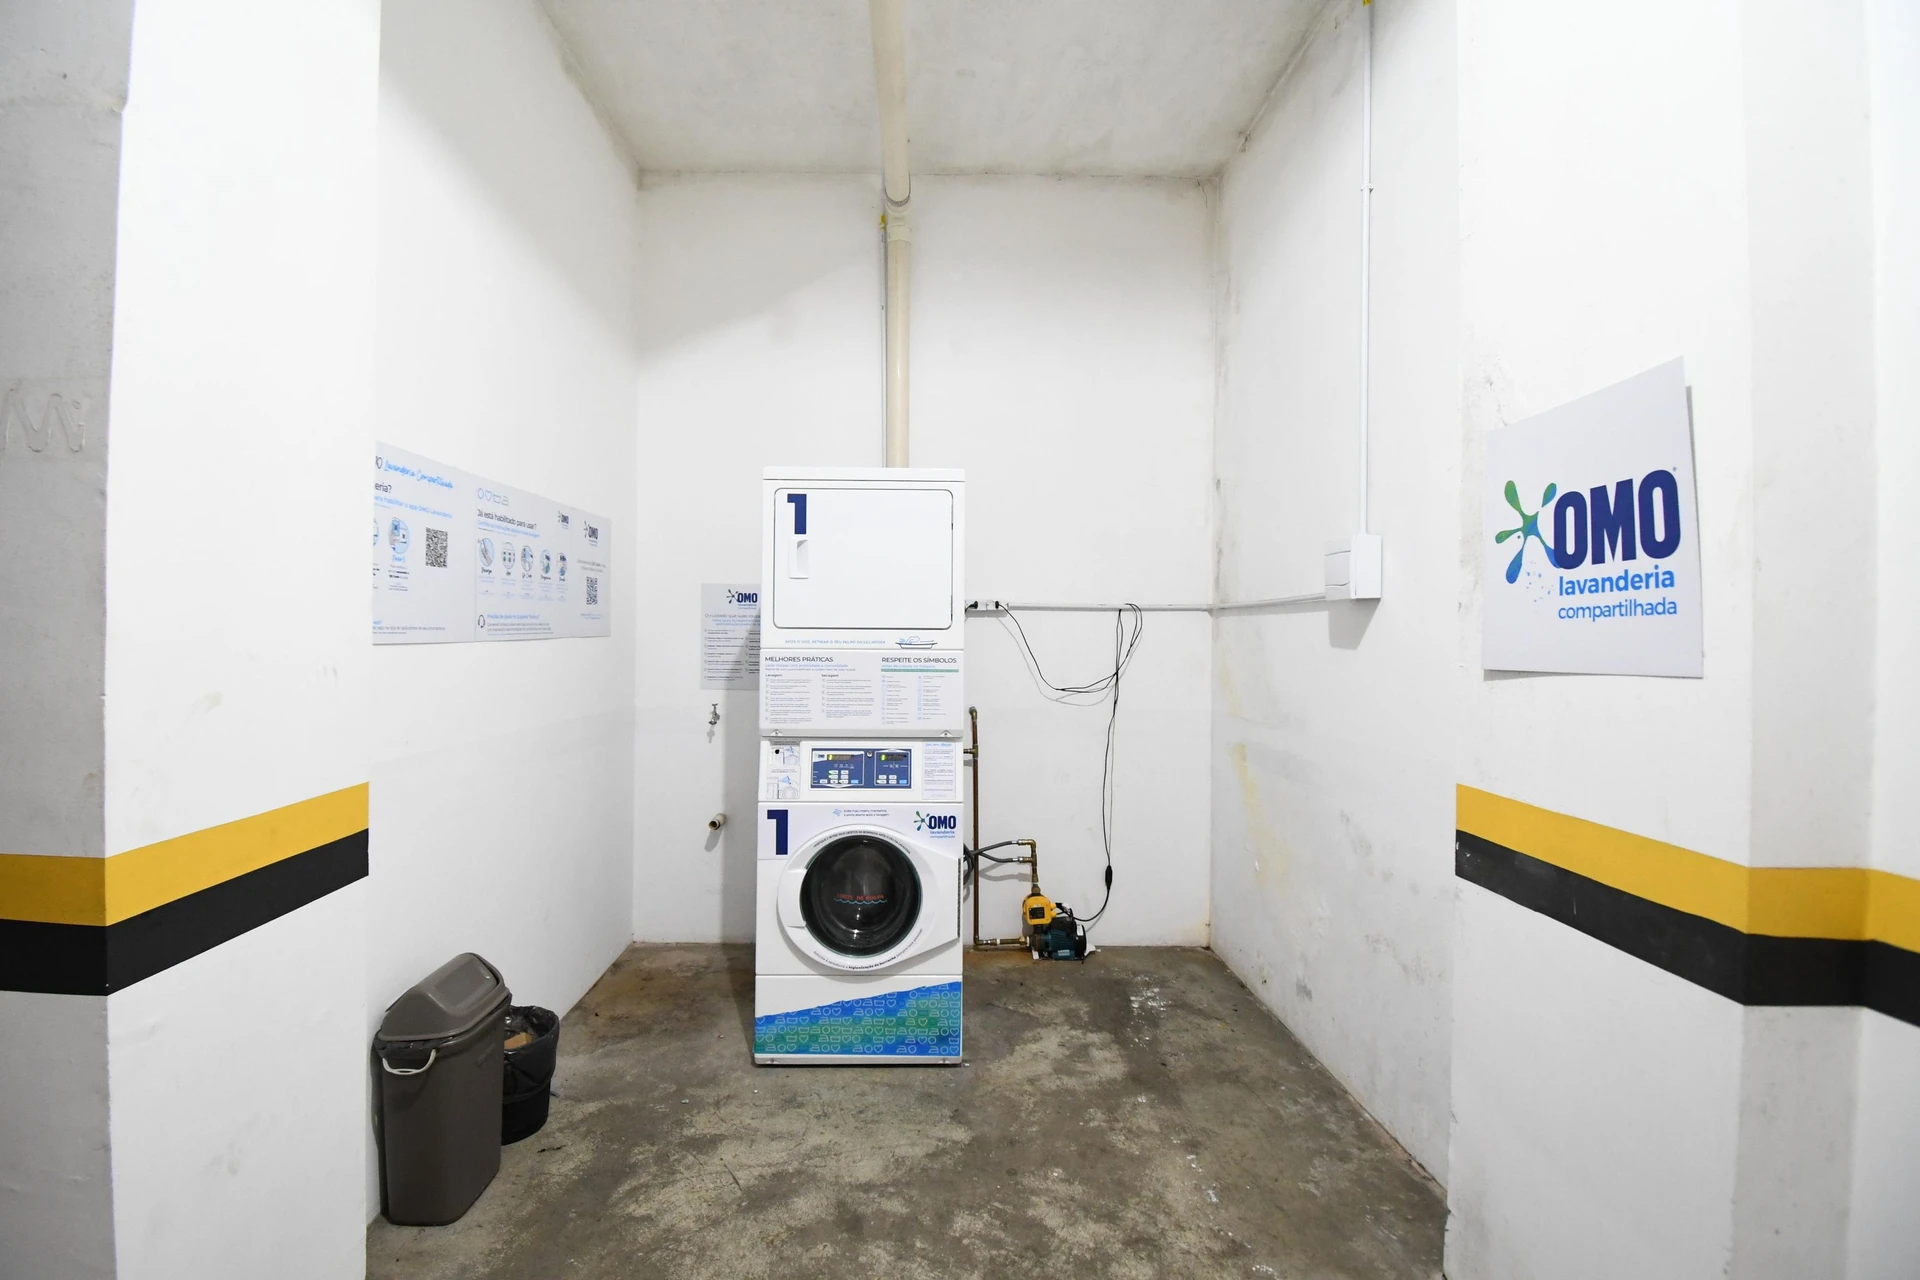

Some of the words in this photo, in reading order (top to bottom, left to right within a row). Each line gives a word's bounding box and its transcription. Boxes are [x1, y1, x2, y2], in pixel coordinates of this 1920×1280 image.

[787, 493, 807, 535] 1
[1553, 469, 1681, 569] OMO
[1559, 564, 1675, 596] lavanderia
[737, 592, 758, 603] OMO
[1558, 597, 1678, 622] compartilhada
[802, 655, 834, 663] PRÁTICAS
[767, 809, 788, 855] 1
[929, 815, 956, 830] OMO
